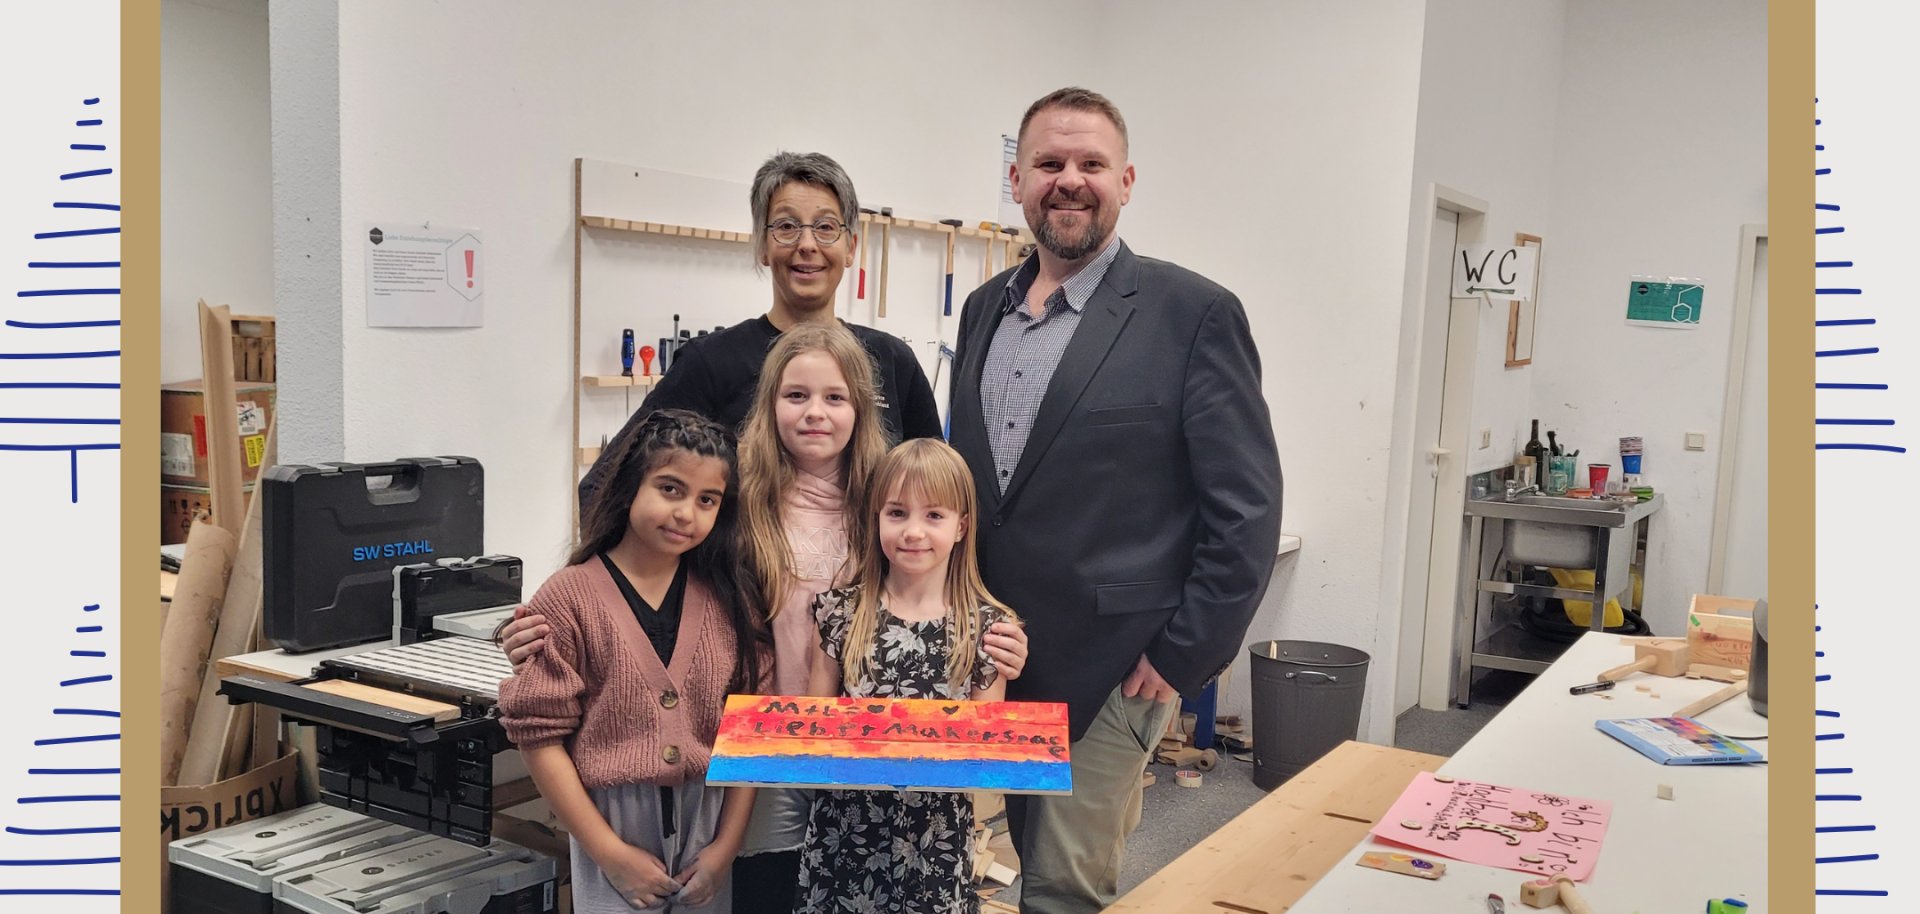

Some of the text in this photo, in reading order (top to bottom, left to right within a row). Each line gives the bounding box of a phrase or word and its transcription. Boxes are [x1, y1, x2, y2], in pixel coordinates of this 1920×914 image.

[1462, 249, 1517, 285] WC
[353, 540, 434, 561] SW STAHL
